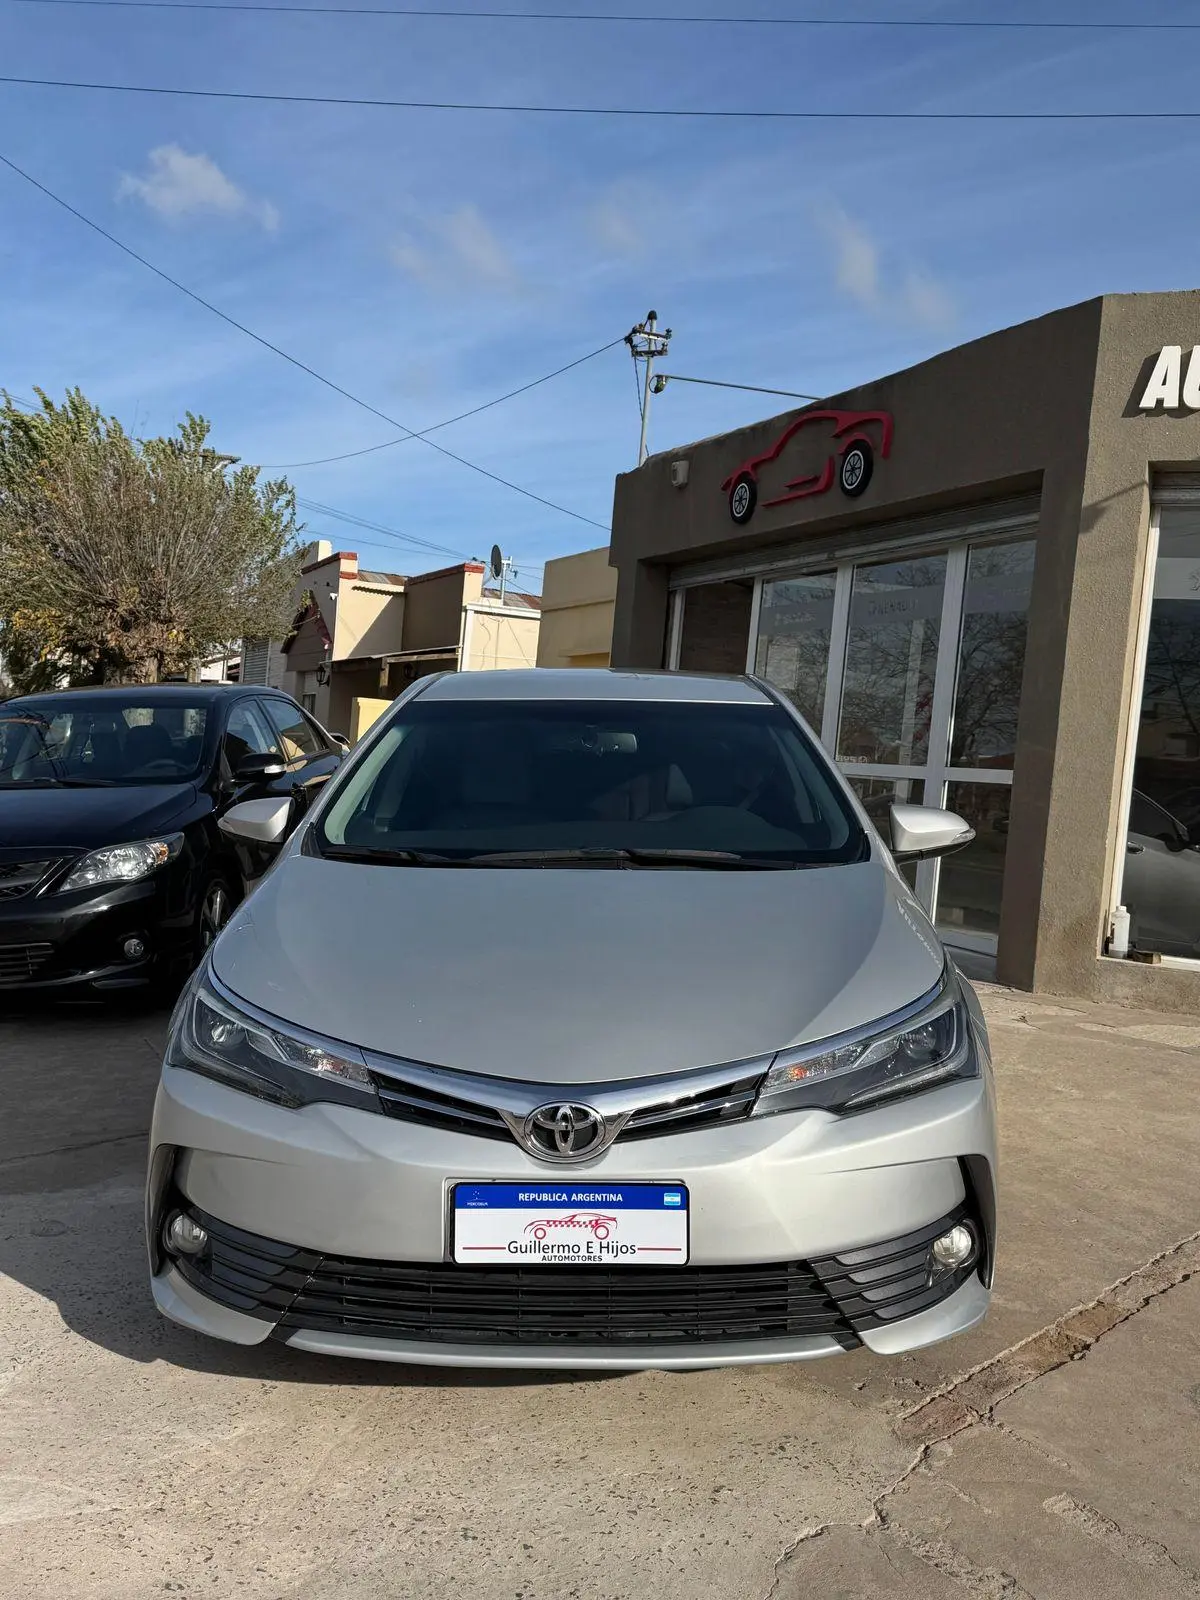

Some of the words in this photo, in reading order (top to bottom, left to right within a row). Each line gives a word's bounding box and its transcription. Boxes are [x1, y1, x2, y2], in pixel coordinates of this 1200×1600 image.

[518, 1193, 568, 1202] REPUBLICA
[571, 1193, 623, 1202] ARGENTINA
[507, 1240, 581, 1254] Guillermo
[586, 1241, 594, 1254] E
[600, 1241, 637, 1258] Hijos
